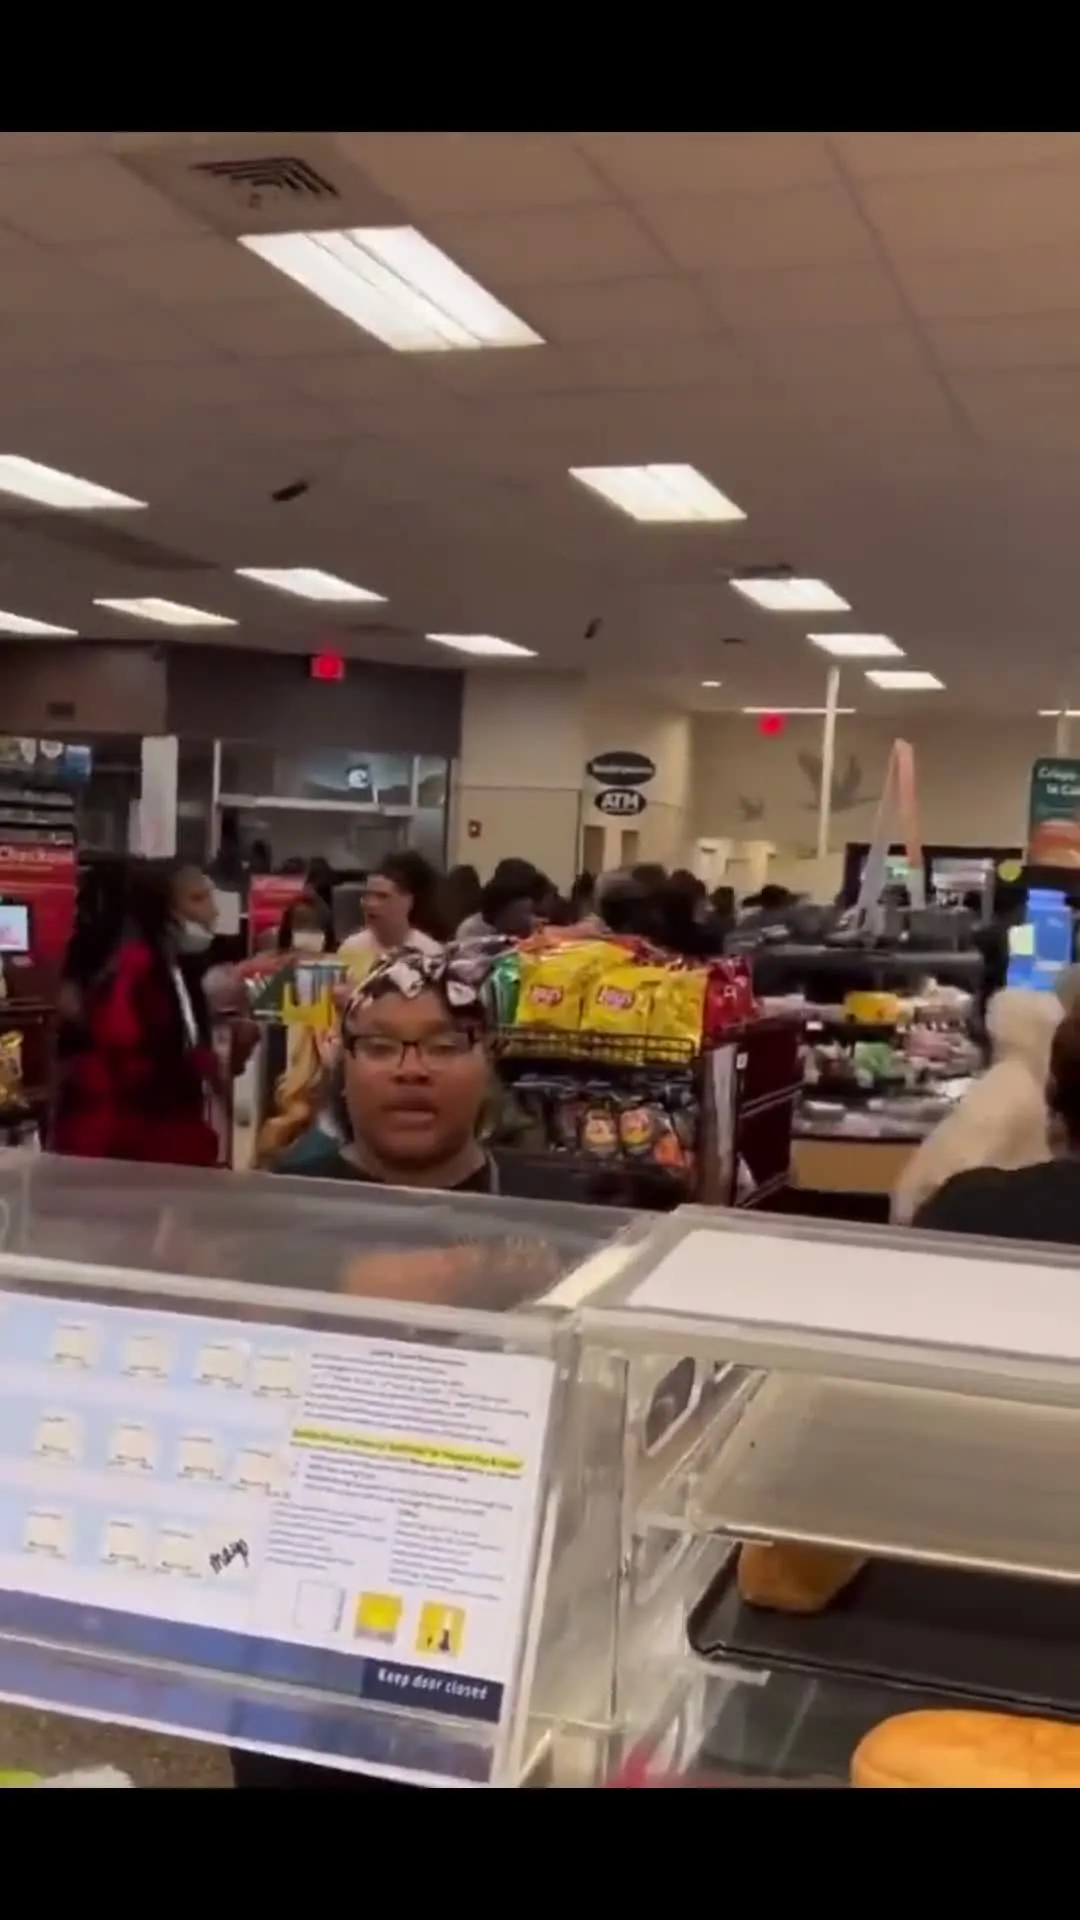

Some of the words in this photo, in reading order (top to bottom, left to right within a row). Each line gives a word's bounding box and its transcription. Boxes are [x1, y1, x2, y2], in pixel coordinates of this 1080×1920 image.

[601, 793, 639, 809] ATM
[377, 1668, 410, 1688] Keep
[411, 1674, 442, 1690] door
[444, 1681, 488, 1700] closed
